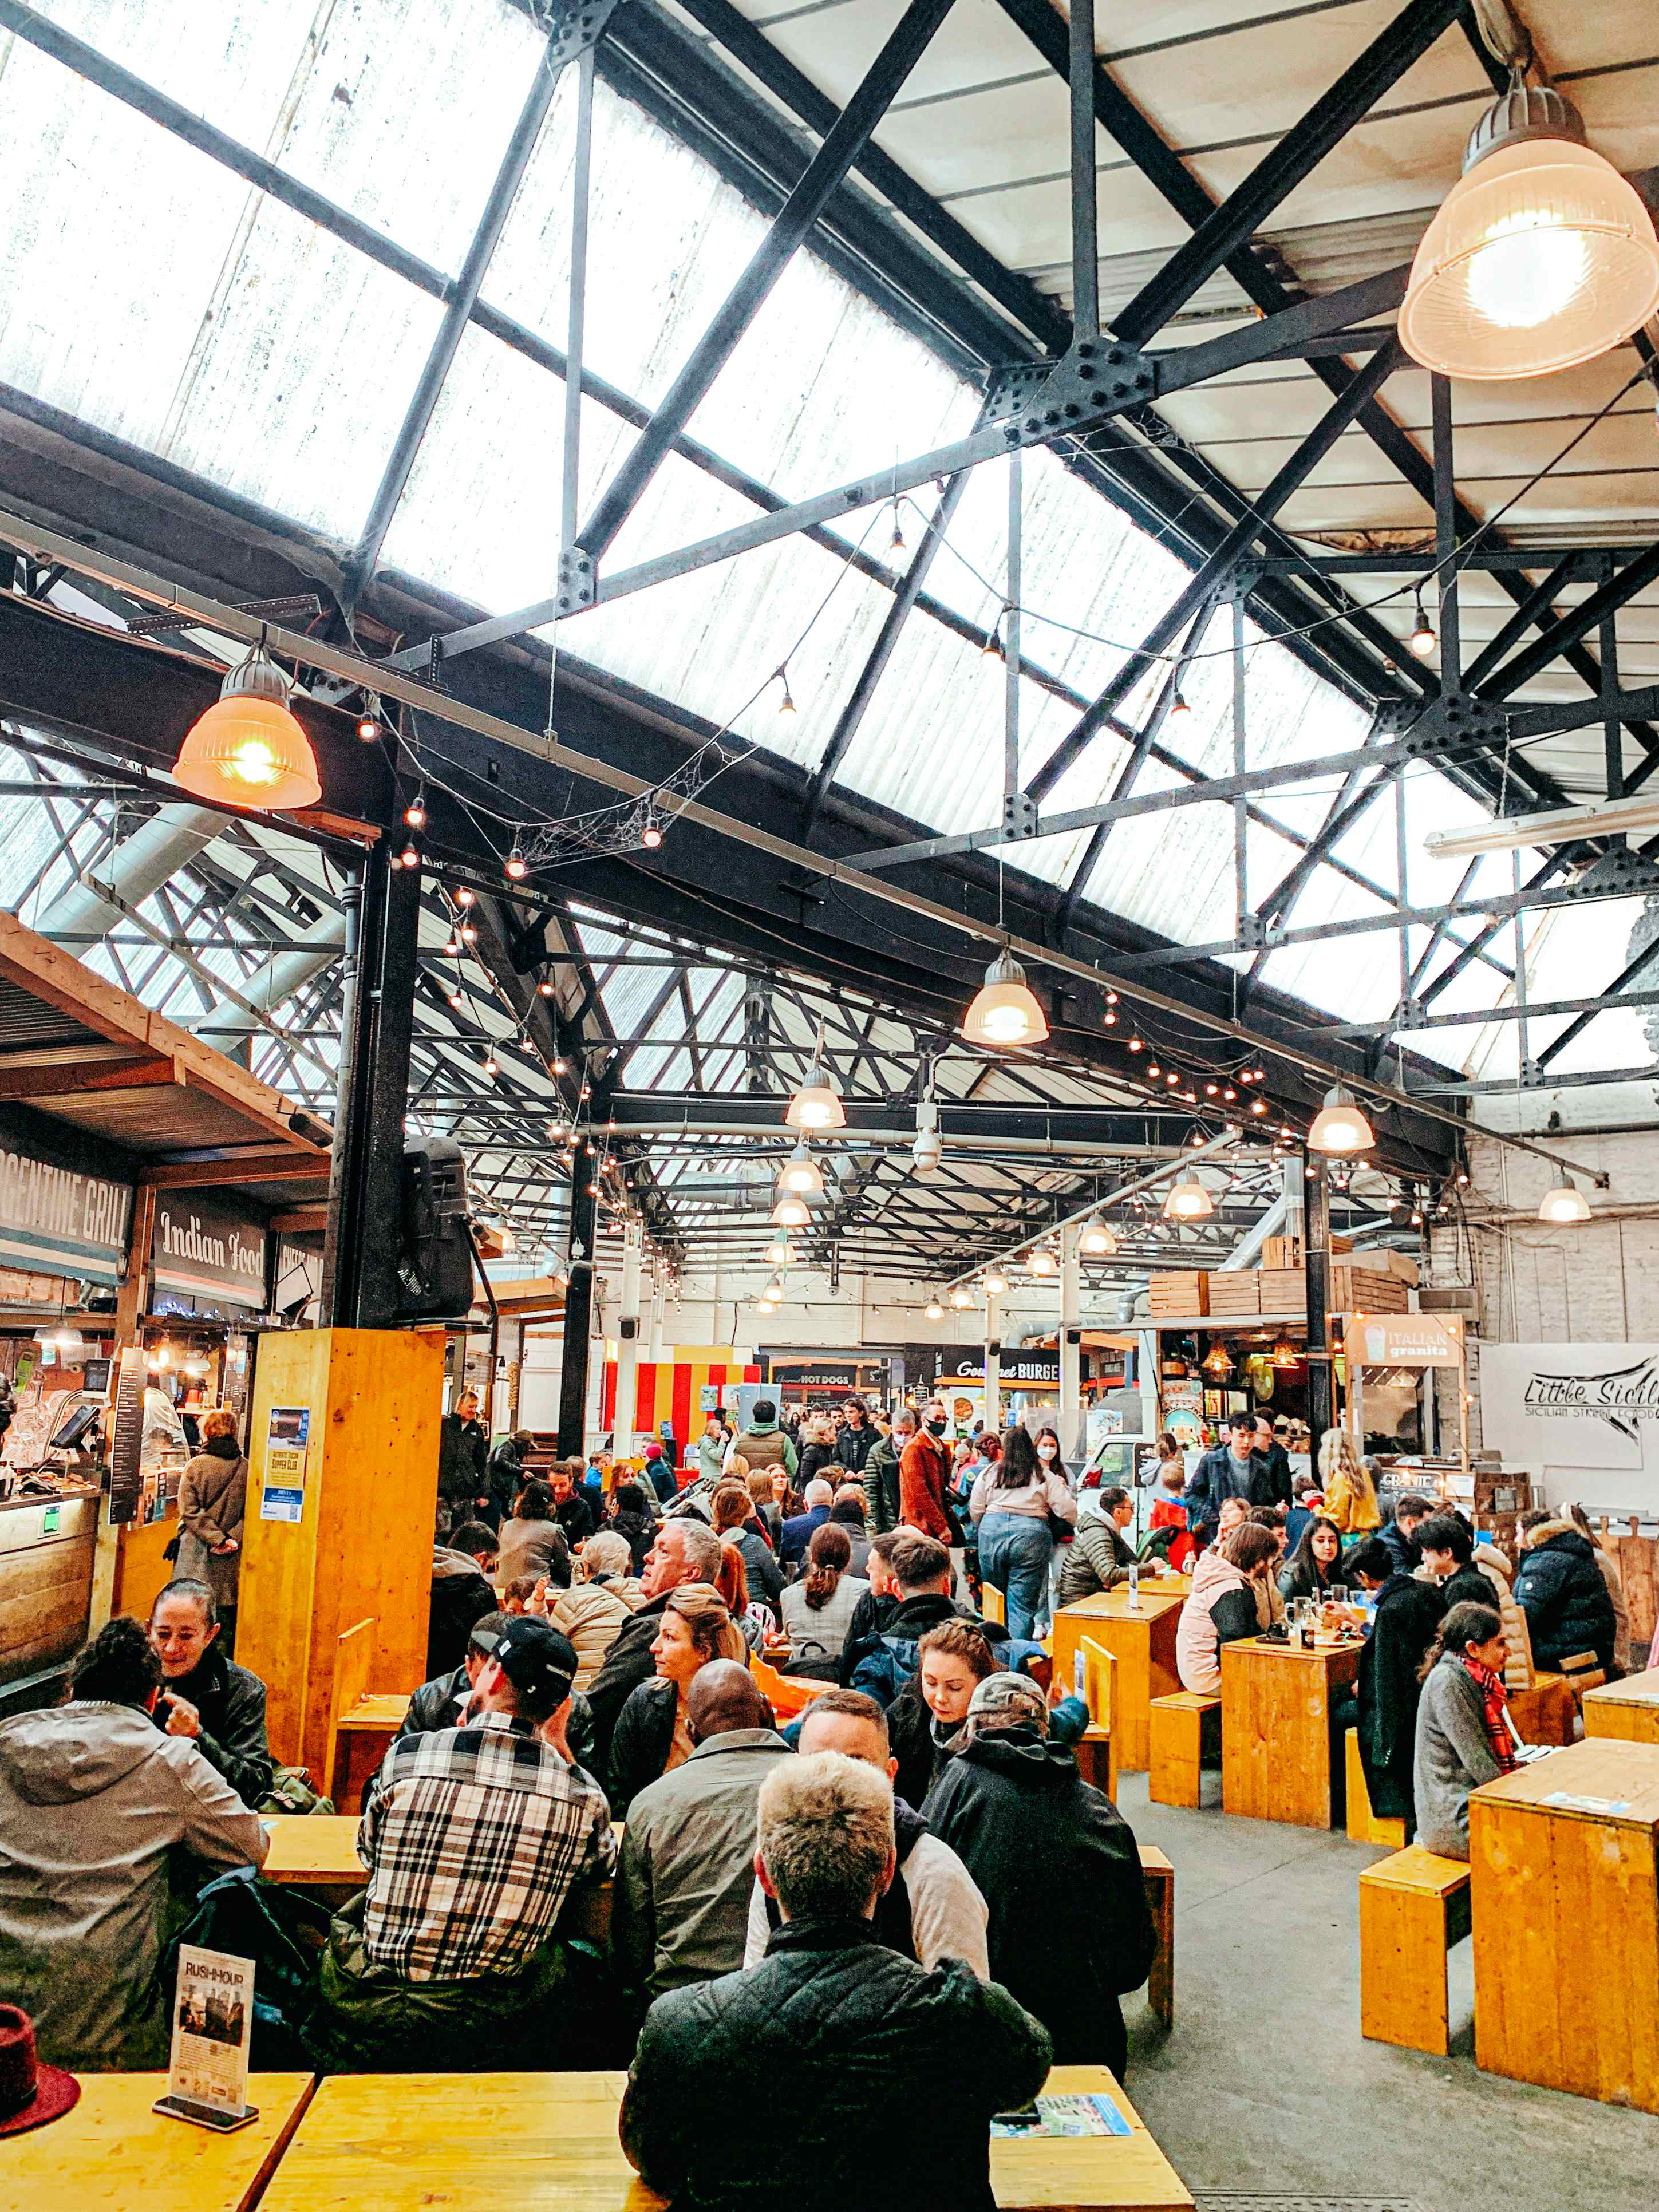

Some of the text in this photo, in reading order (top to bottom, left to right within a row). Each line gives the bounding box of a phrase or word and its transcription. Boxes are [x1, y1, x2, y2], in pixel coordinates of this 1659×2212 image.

[83, 1179, 127, 1249] GRILL
[161, 1211, 225, 1268] Indian
[229, 1231, 264, 1277] Food
[1389, 1331, 1448, 1345] ITALIAN
[1390, 1346, 1448, 1358] granita
[957, 1361, 1017, 1378] Gouet
[1018, 1363, 1058, 1380] BURGE
[801, 1375, 821, 1384] HOT
[821, 1376, 848, 1384] DOGS
[1524, 1378, 1659, 1405] Little Sicil
[1525, 1407, 1567, 1417] SICILIAN
[1618, 1410, 1654, 1419] FOOD
